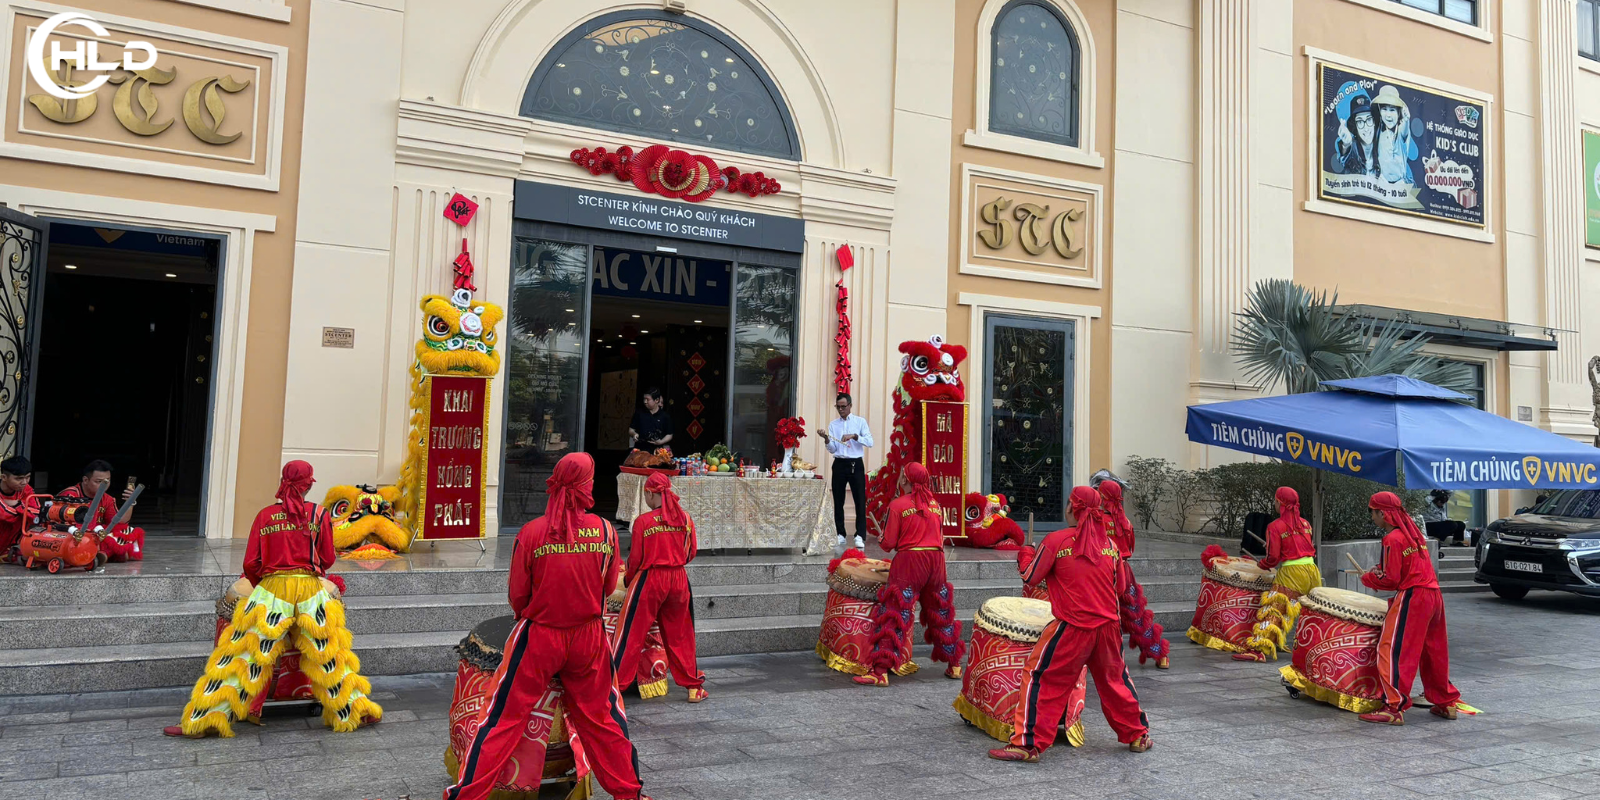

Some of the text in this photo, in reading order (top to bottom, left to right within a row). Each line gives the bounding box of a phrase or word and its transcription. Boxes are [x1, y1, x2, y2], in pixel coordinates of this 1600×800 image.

[1345, 81, 1358, 94] and
[1435, 136, 1479, 157] KID'S CLUB
[578, 194, 755, 228] STCENTER KÍNH CHÀO QUÝ KHÁCH
[156, 233, 205, 247] Vietnam
[608, 215, 729, 240] WELCOME TO STCENTER
[977, 196, 1085, 259] STC
[640, 256, 697, 297] XIN
[443, 389, 473, 412] KHAI
[431, 425, 481, 449] TRƯƠNG
[1211, 421, 1362, 472] TIÊM CHỦNG VNVC
[1430, 456, 1597, 484] TIÊM CHỦNG VNVC
[433, 498, 472, 526] PHÁT
[578, 527, 600, 538] NAM
